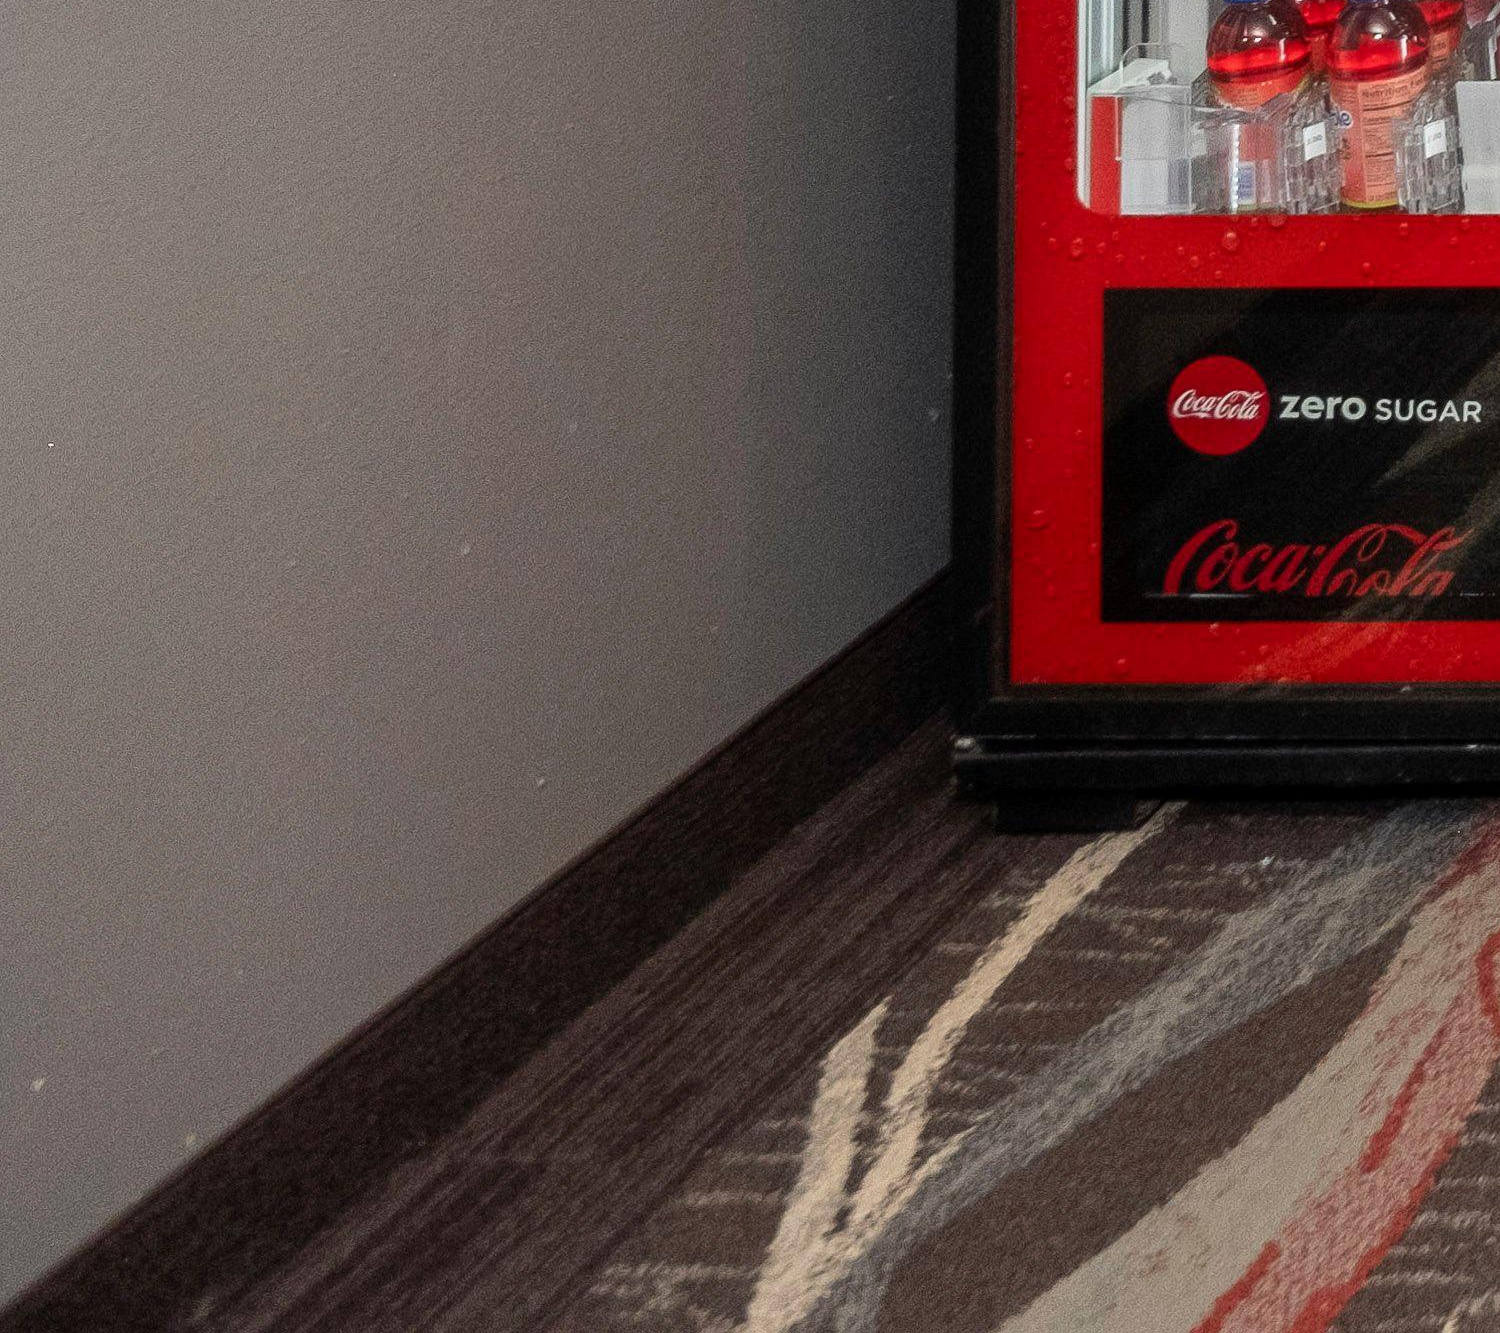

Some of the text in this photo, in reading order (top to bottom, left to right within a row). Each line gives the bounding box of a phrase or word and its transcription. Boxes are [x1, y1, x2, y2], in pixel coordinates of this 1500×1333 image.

[1171, 388, 1482, 423] Coca-Cola zero SUGAR
[1162, 518, 1474, 597] Coca-Cola
